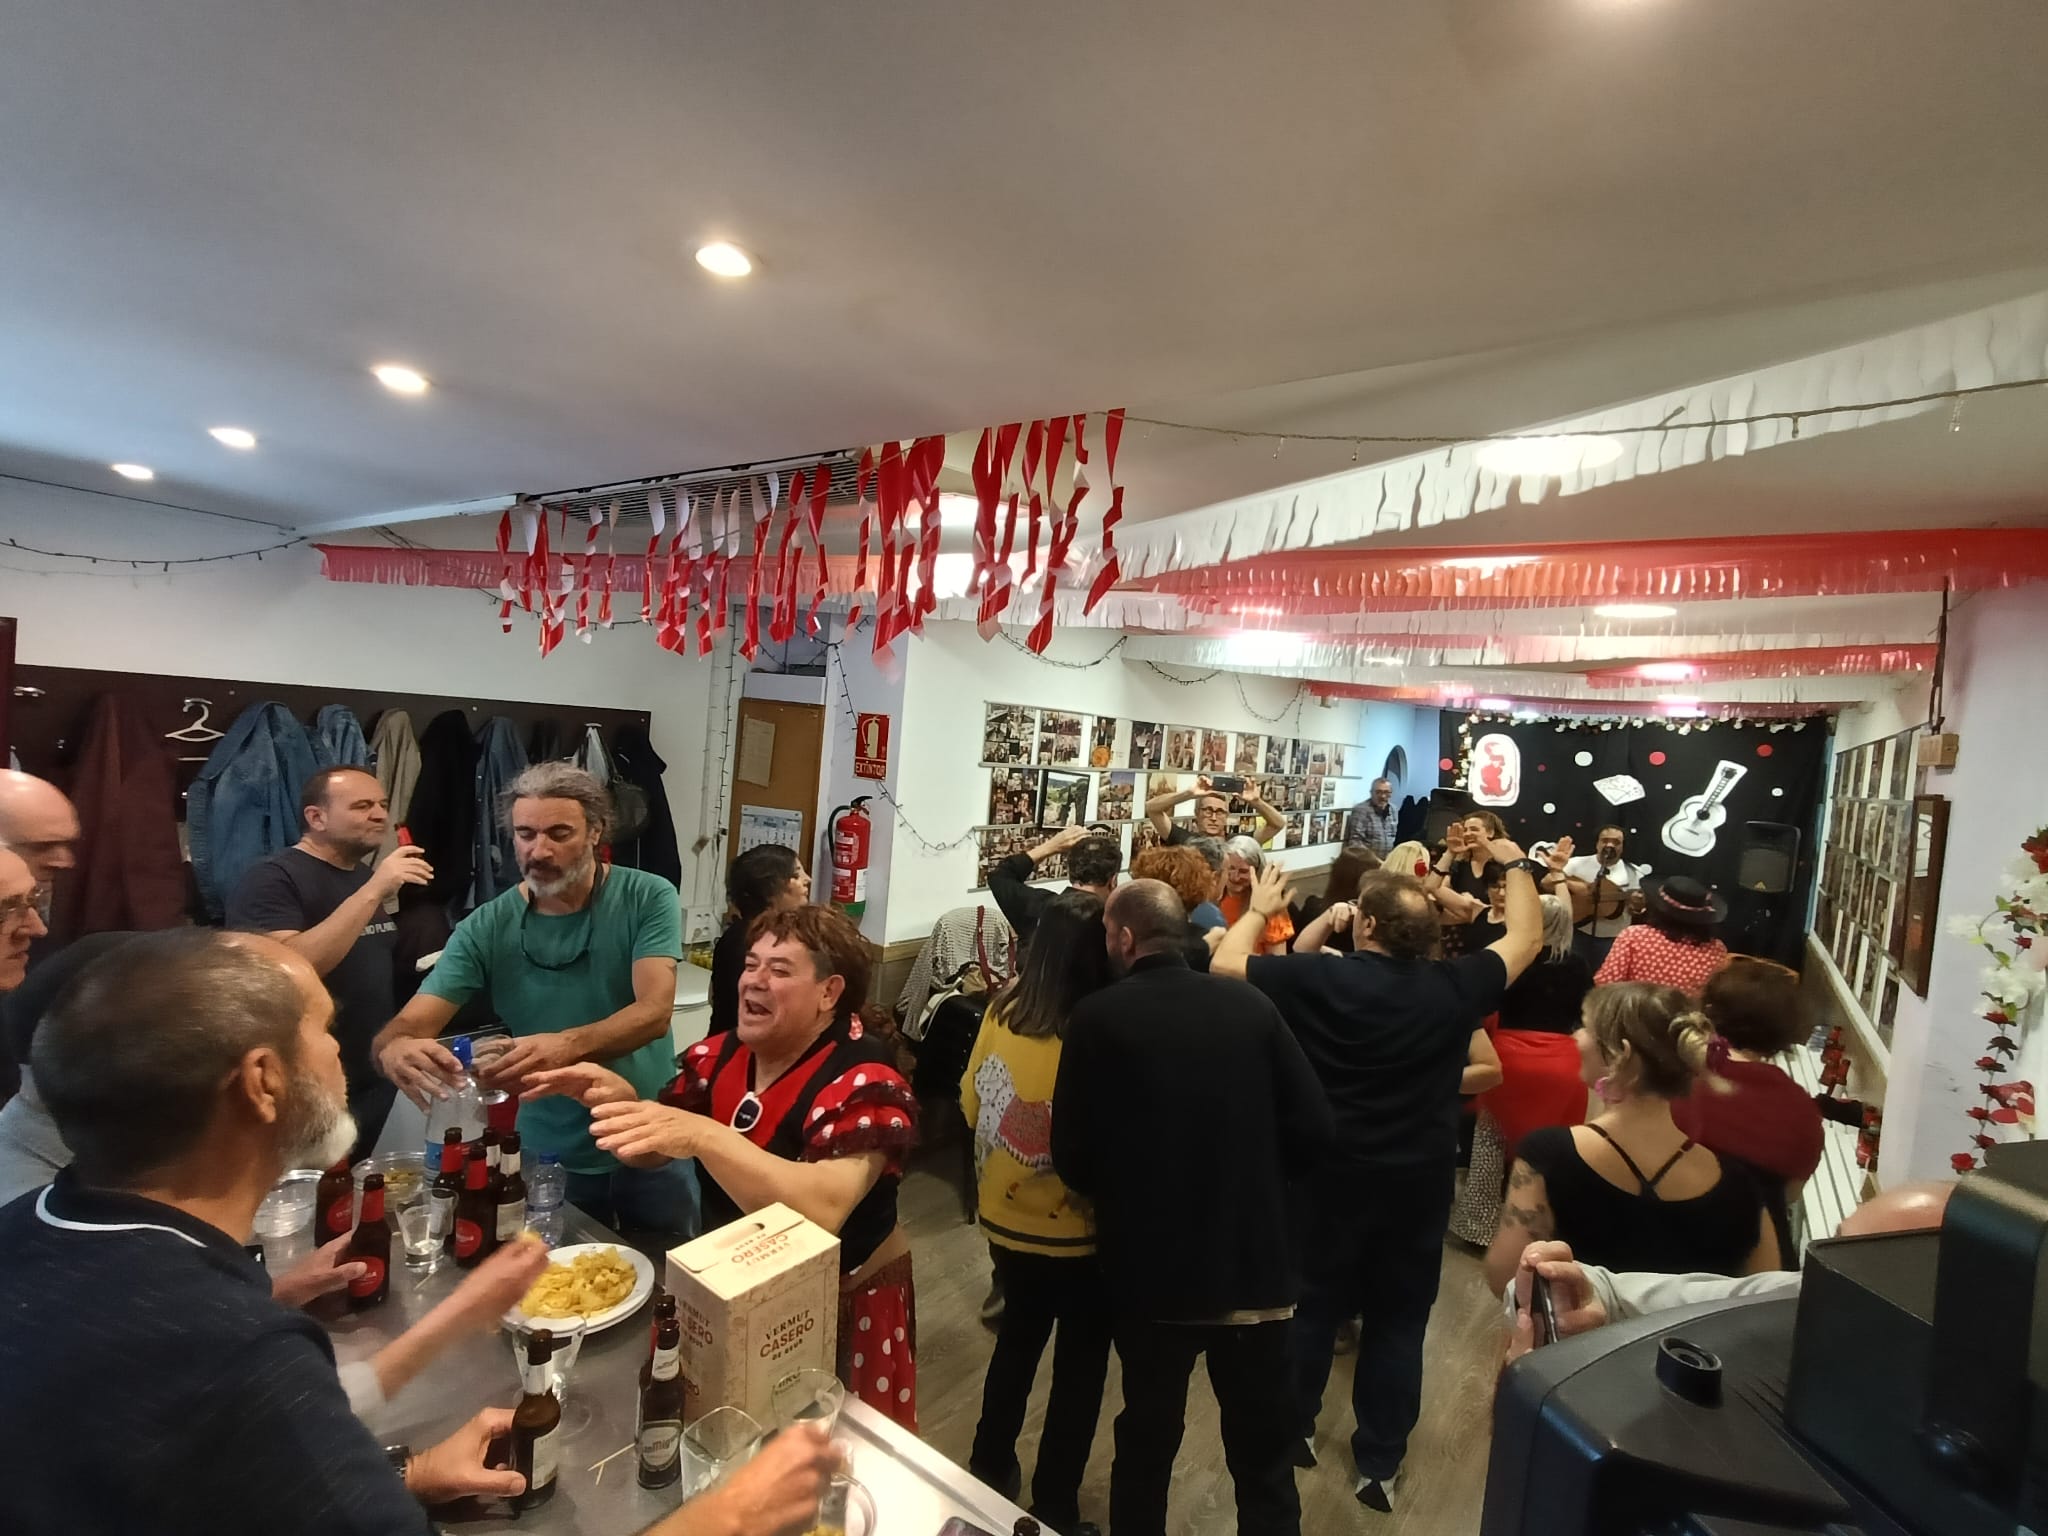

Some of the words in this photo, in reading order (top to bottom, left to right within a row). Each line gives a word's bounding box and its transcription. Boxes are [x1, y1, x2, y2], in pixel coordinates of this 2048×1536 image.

[856, 762, 886, 777] EXTINTOR
[731, 1234, 788, 1263] CASERO
[760, 1318, 814, 1357] CASERO
[766, 1309, 809, 1340] VERMUT
[772, 1352, 781, 1361] DE
